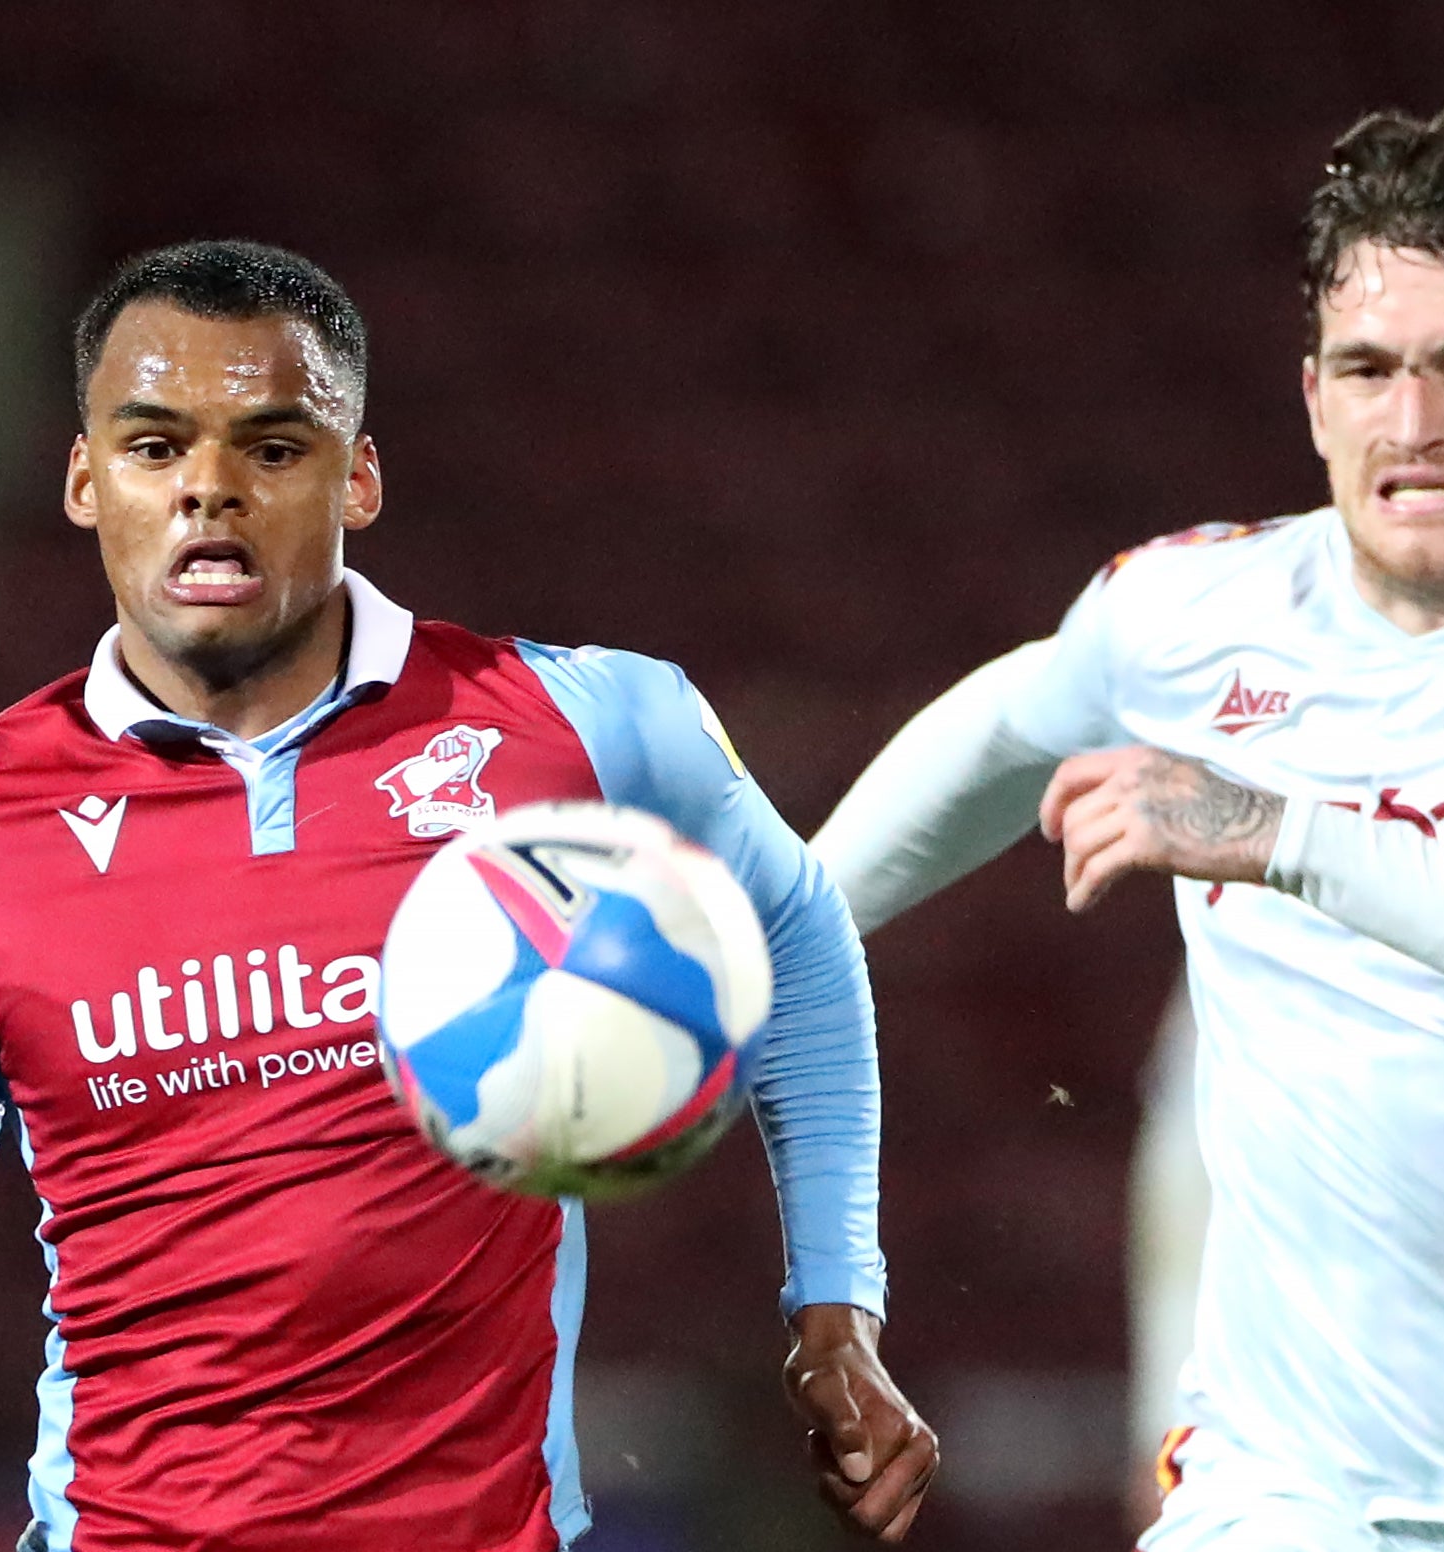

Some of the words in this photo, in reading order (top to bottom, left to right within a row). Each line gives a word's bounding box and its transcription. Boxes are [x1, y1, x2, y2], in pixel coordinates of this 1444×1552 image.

[70, 944, 383, 1064] utilita
[87, 1072, 148, 1111] life
[156, 1052, 247, 1098] with
